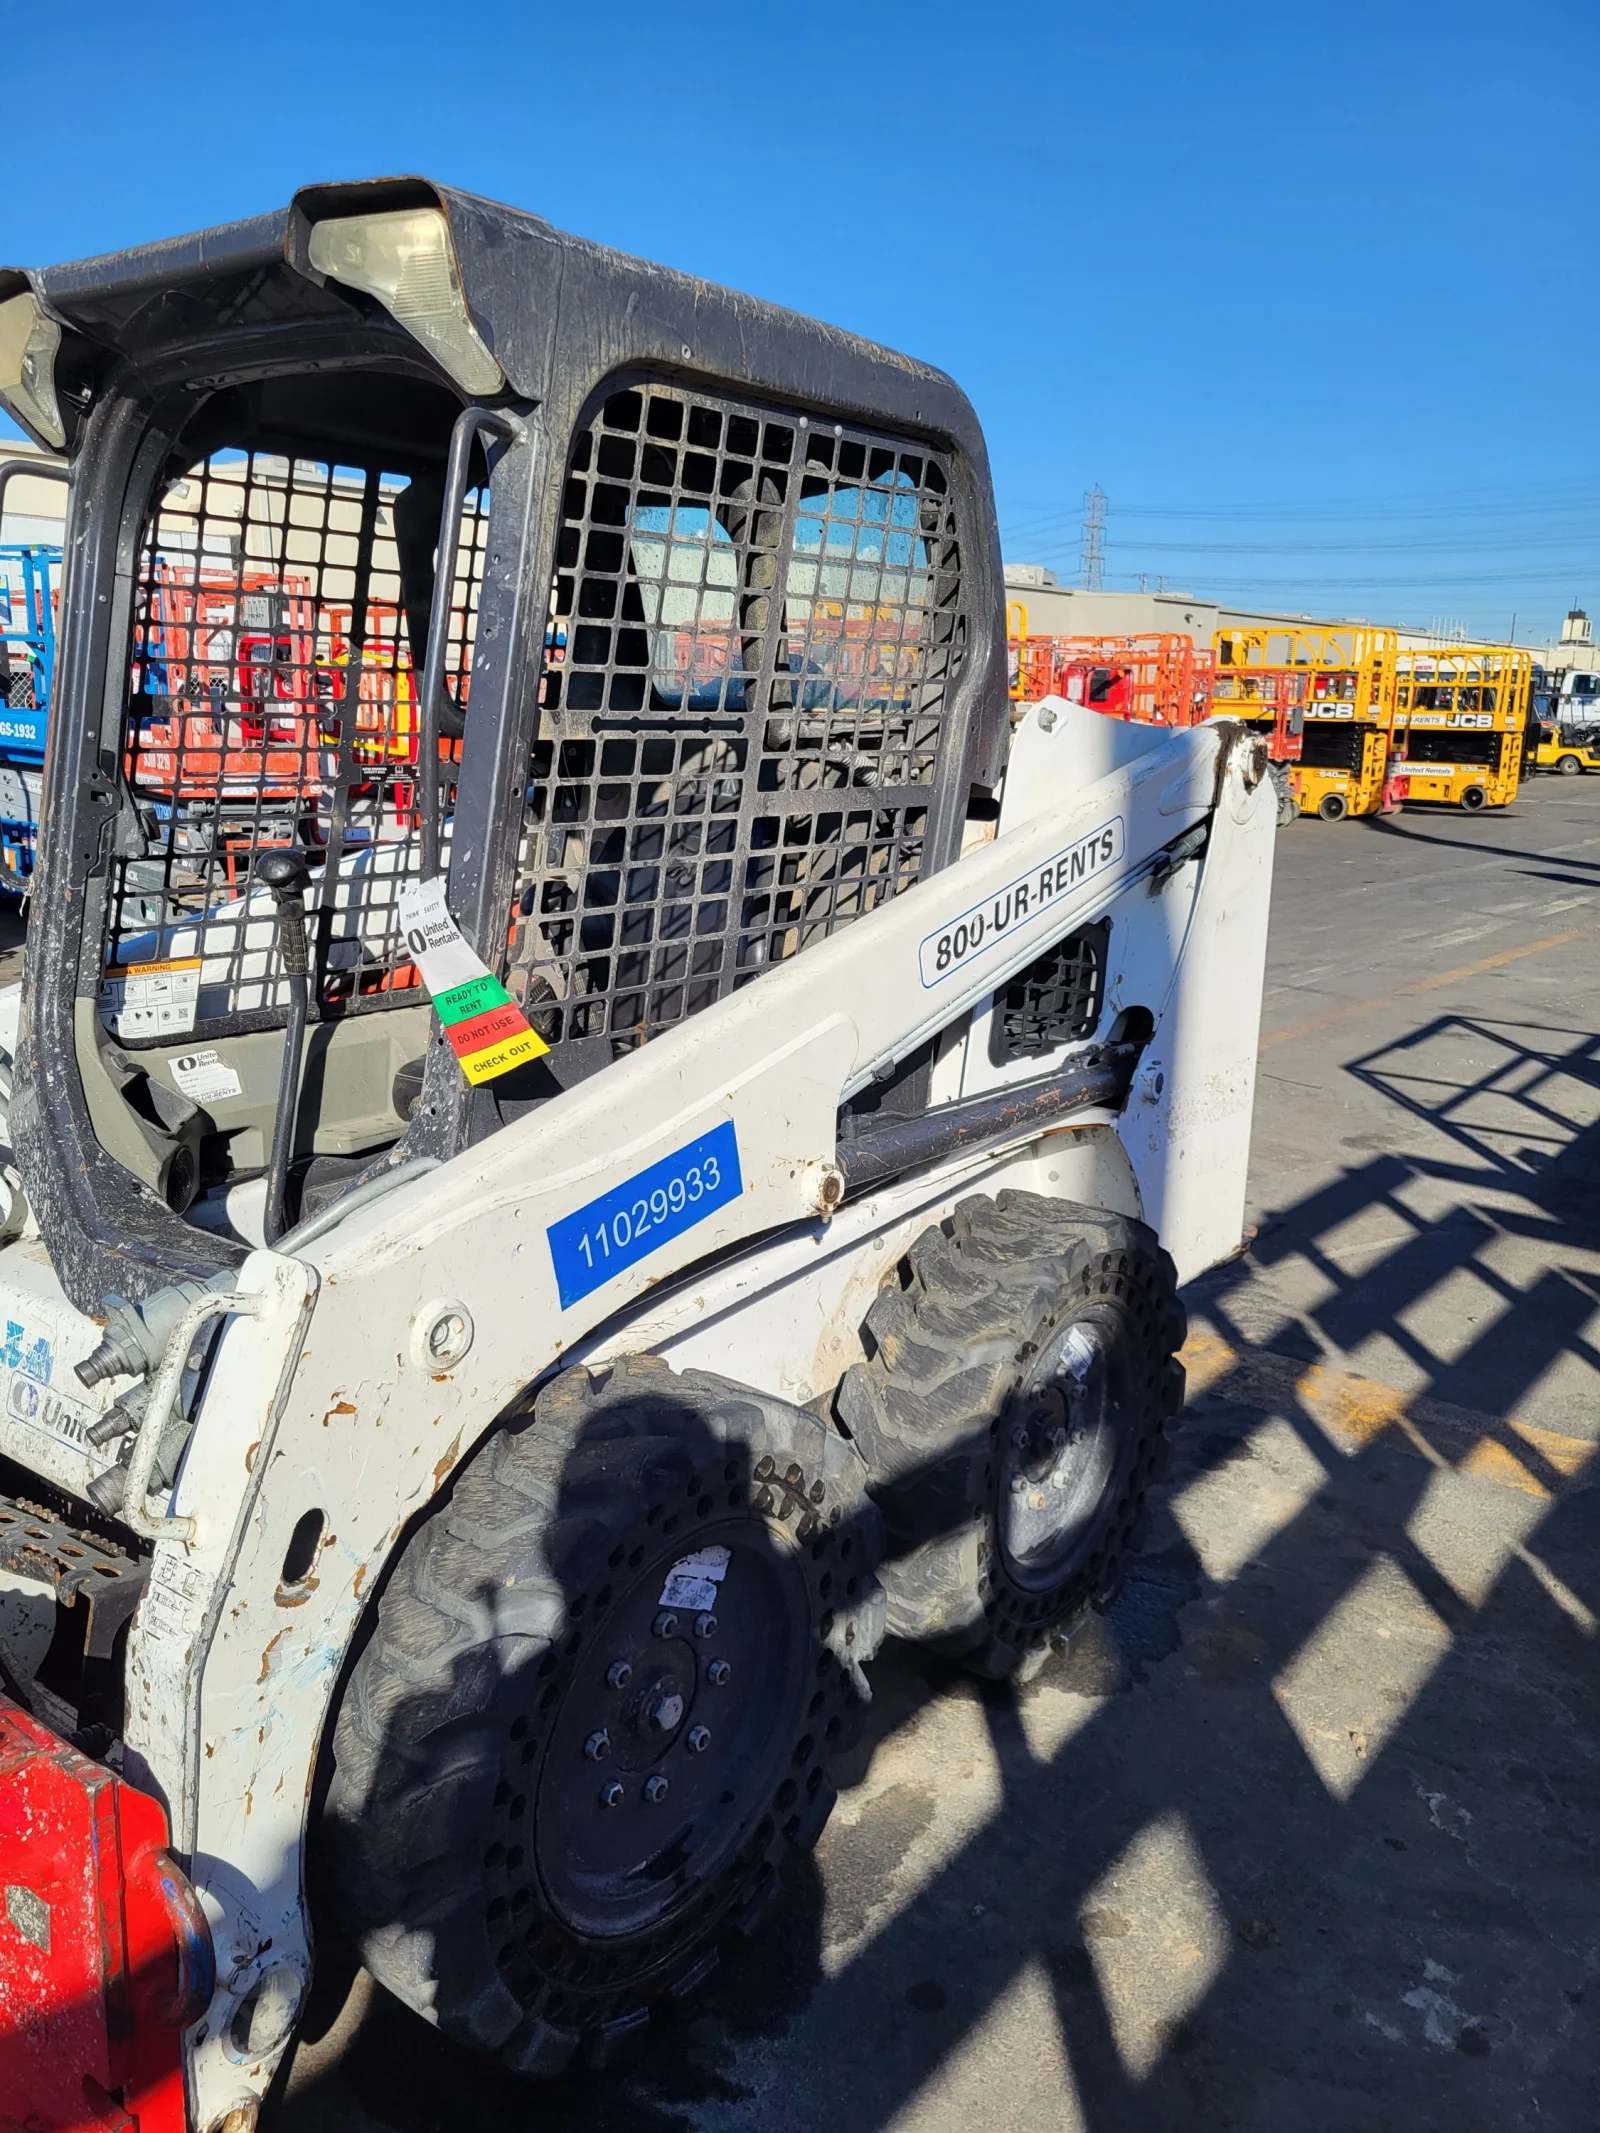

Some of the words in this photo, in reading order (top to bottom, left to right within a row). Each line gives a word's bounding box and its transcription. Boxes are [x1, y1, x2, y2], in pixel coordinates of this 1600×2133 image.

[1304, 702, 1354, 719] JCB
[0, 720, 36, 740] GS-1932
[1447, 714, 1493, 728] JCB
[1425, 767, 1451, 775] Rentals
[934, 828, 1116, 972] 800-UR-RENTS
[405, 909, 420, 921] THINK
[423, 901, 440, 914] SAFETY
[423, 919, 450, 937] United
[428, 930, 460, 949] Rentals
[134, 964, 171, 974] WARNING
[445, 988, 473, 1006] READY
[474, 982, 488, 994] TO
[459, 999, 483, 1015] RENT
[457, 1034, 470, 1045] DO
[471, 1025, 491, 1040] NOT
[492, 1016, 515, 1031] USE
[473, 1053, 508, 1073] CHECK
[509, 1042, 532, 1056] OUT
[576, 1155, 723, 1269] 11029933
